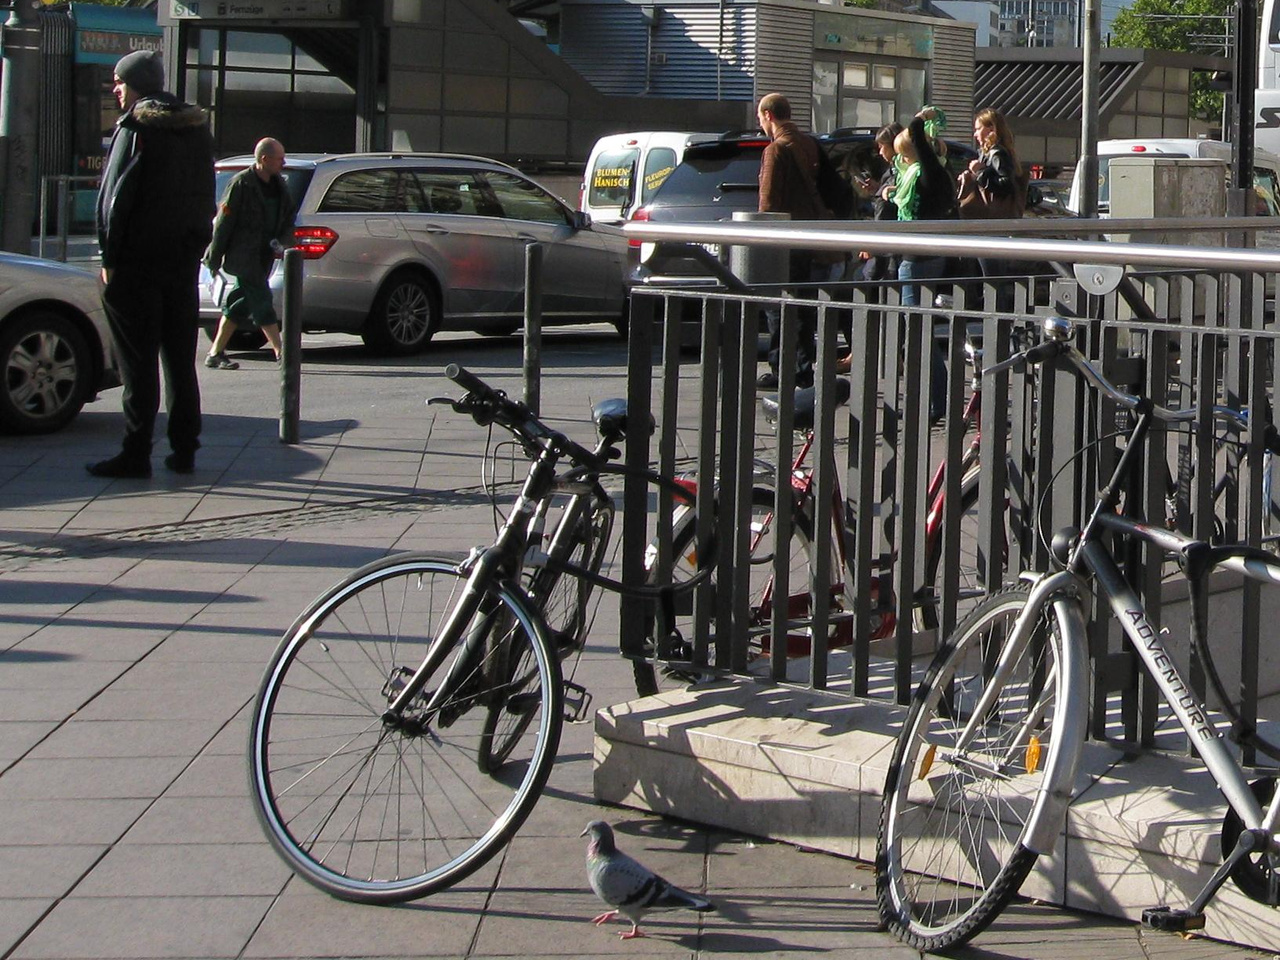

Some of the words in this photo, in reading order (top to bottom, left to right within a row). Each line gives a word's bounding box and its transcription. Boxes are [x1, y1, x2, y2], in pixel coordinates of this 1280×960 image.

[229, 4, 264, 16] Fernzüge
[596, 167, 632, 177] BLUMEN-
[644, 166, 675, 184] FLEUROP-
[1125, 607, 1214, 742] ADVENTURE
